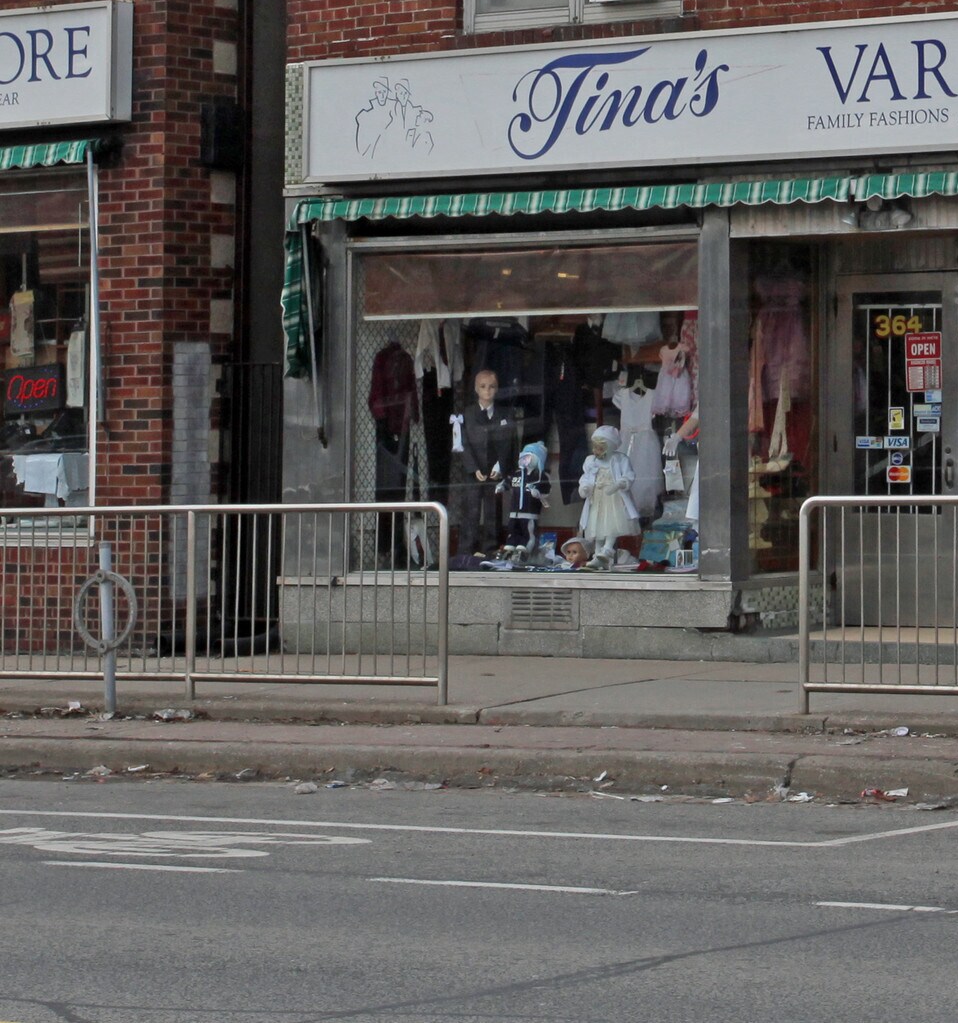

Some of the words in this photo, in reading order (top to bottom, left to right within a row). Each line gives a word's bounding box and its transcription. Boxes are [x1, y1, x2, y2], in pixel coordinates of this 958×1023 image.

[507, 45, 730, 160] Tina's
[806, 112, 865, 130] FAMILY
[869, 107, 950, 127] FASHIONS
[875, 314, 923, 337] 364
[911, 342, 936, 356] OPEN
[6, 374, 57, 405] Open
[888, 437, 908, 447] VISA
